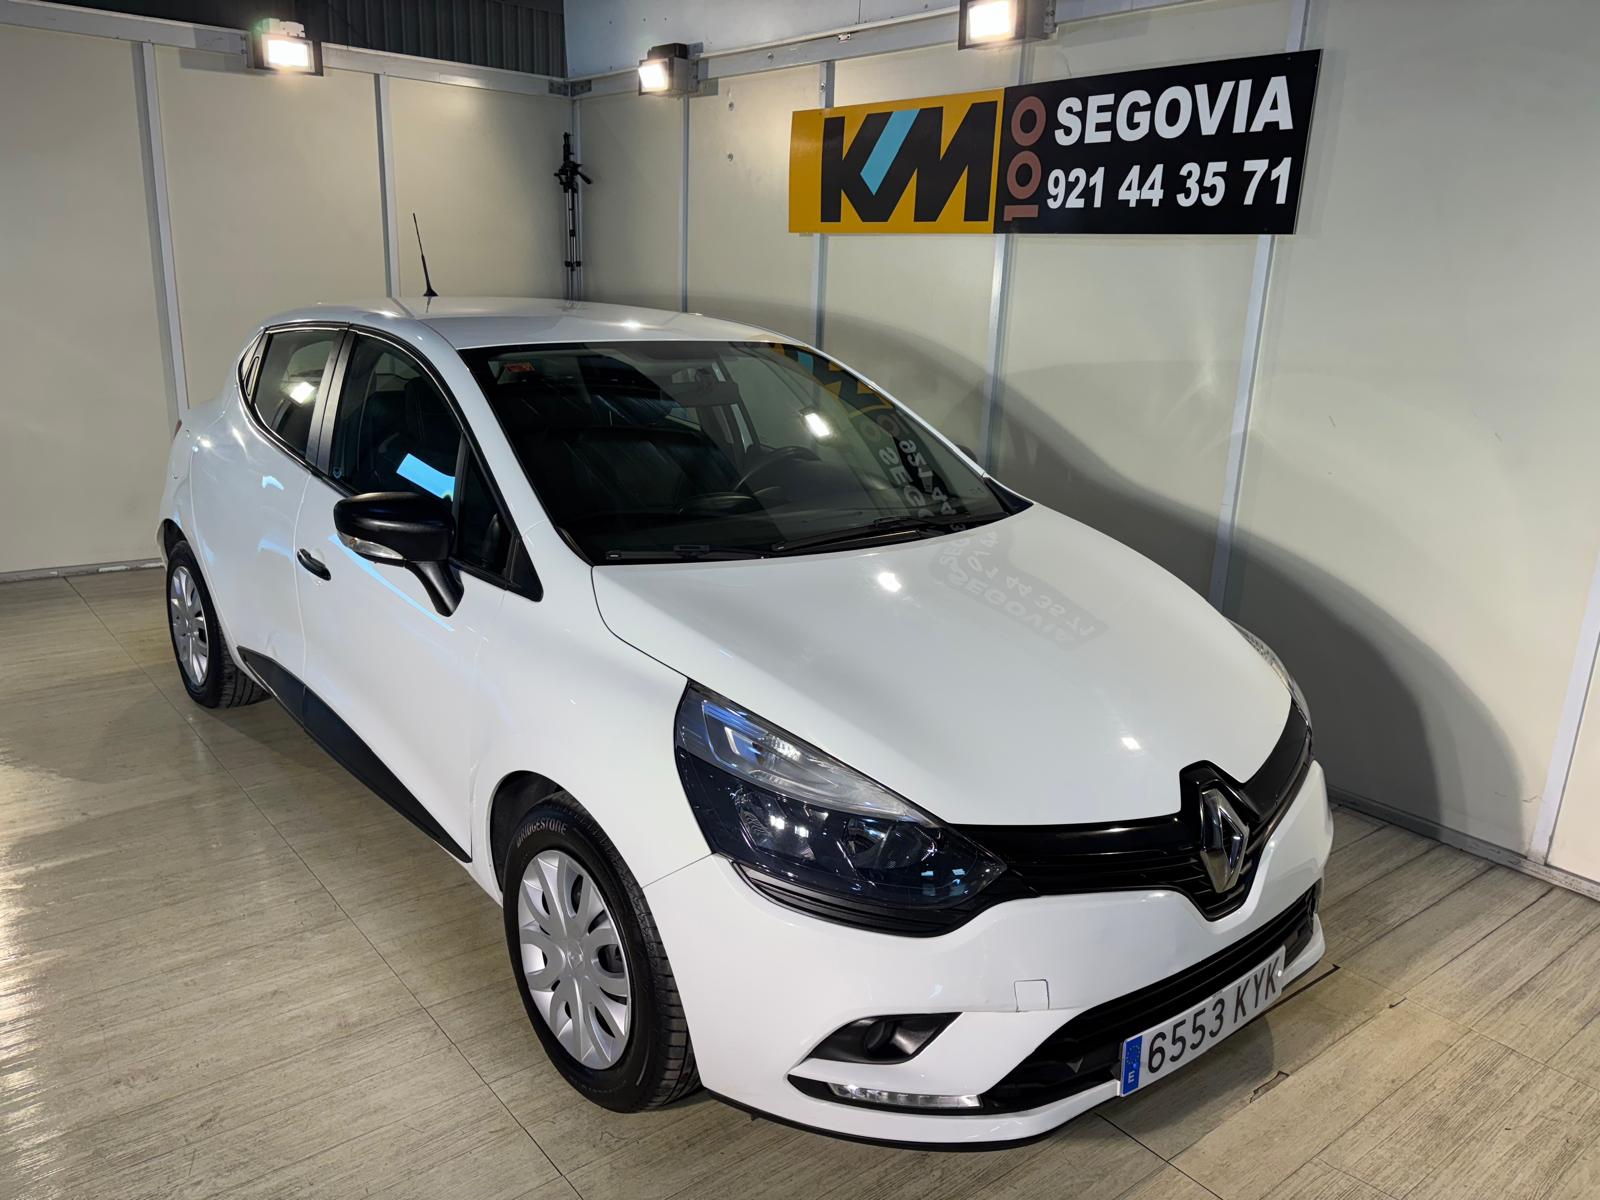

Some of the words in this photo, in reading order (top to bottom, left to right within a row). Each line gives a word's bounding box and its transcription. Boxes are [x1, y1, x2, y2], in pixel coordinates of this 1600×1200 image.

[1054, 75, 1294, 145] SEGOVIA
[820, 101, 998, 222] KM
[1003, 95, 1047, 221] 100
[1046, 165, 1103, 209] 921
[1117, 163, 1164, 207] 44
[1176, 161, 1227, 206] 35
[1242, 157, 1293, 204] 71
[516, 817, 568, 848] BRIDGESTONE
[1147, 998, 1226, 1074] 6553
[1233, 956, 1280, 1024] KYK
[1127, 1071, 1135, 1084] E
